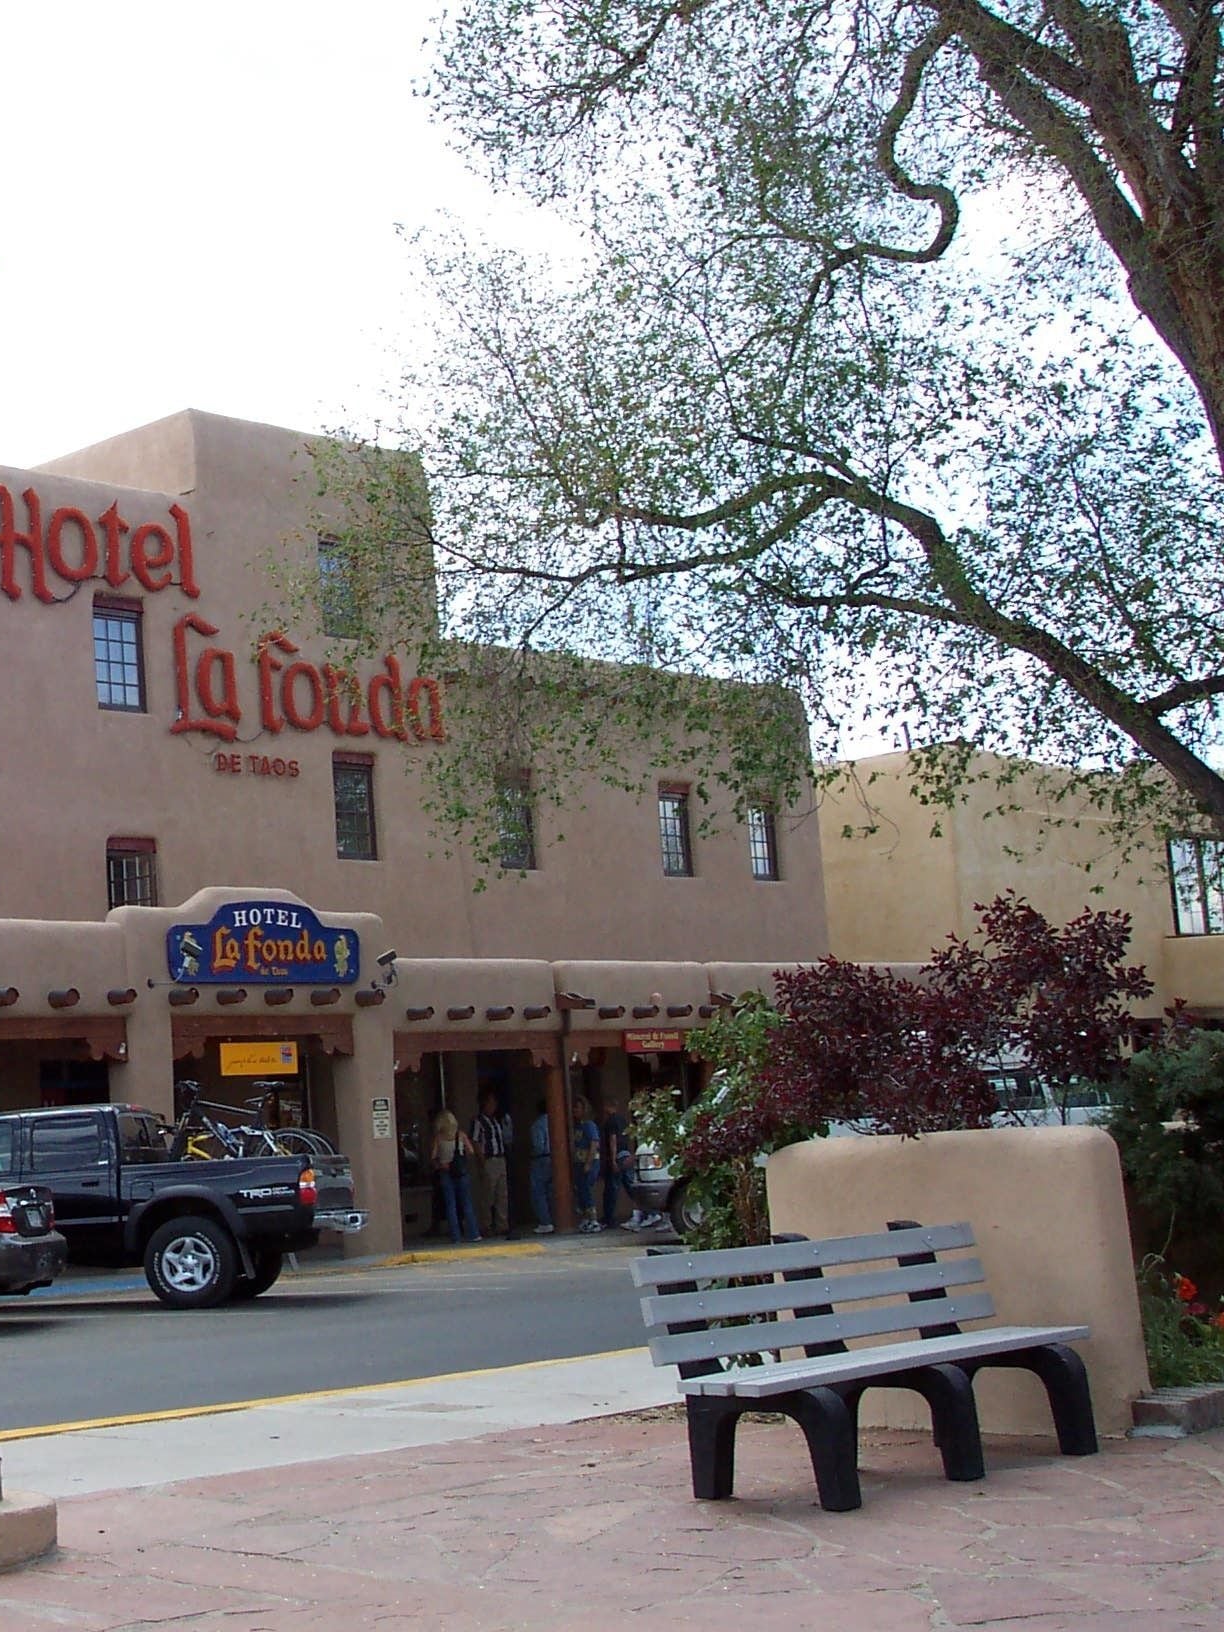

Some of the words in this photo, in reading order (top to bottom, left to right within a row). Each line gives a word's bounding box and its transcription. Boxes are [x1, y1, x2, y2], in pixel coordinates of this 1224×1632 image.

[170, 612, 242, 743] La
[215, 753, 242, 773] DE
[248, 755, 301, 778] TAOS
[232, 908, 302, 928] HOTEL
[212, 926, 241, 971] La
